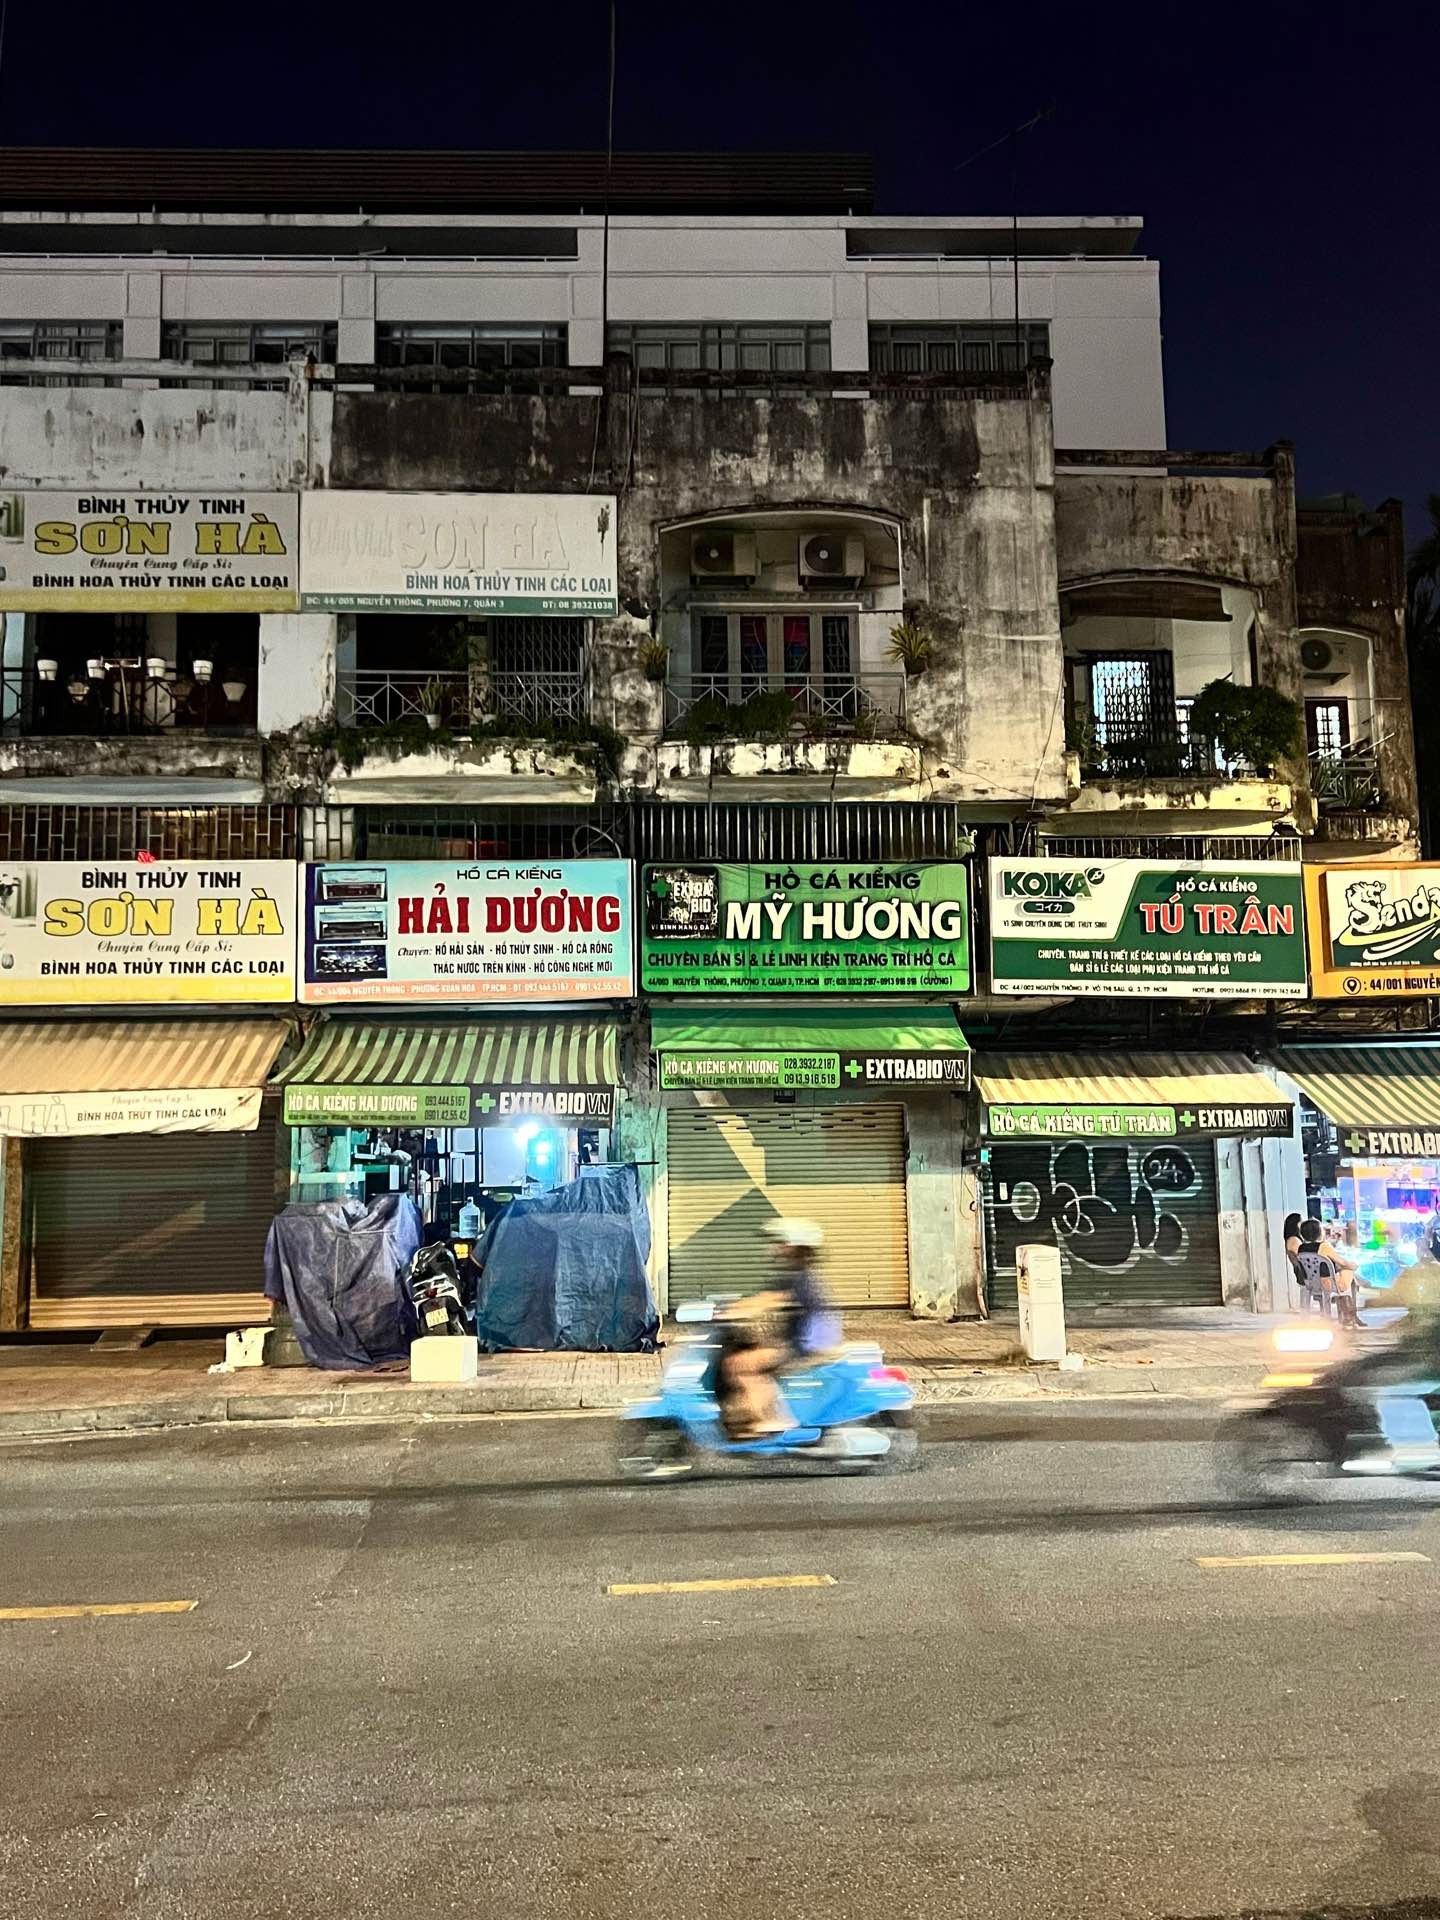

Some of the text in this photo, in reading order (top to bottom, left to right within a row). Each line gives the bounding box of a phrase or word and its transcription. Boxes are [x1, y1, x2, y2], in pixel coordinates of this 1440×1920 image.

[78, 495, 245, 514] BÌNH THỦY TINH
[34, 516, 171, 555] SƠN
[195, 513, 287, 554] HÀ
[90, 558, 139, 570] Chuyên
[144, 558, 178, 570] Cung
[32, 572, 288, 590] BÌNH HOA THỦY TINH CÁC LOẠI
[406, 570, 611, 595] BÌNH HOA THỦY TINH CÁC LOẠI
[82, 866, 241, 889] BÌNH THỦY TINH
[765, 866, 921, 889] HỒ CÁ KIỂNG
[1004, 872, 1092, 897] KOIKA
[1199, 878, 1217, 891] CÁ
[44, 888, 284, 937] SƠN HÀ
[397, 882, 620, 934] HẢI DƯƠNG
[692, 898, 711, 913] BIO
[1035, 903, 1063, 912] コイカ
[1140, 893, 1294, 934] TÚ TRÂN
[725, 892, 961, 940] MỸ HƯƠNG
[148, 940, 181, 954] Cung
[533, 944, 554, 954] SINH
[40, 957, 285, 977] BÌNH HOA THỦY TINH CÁC LOẠI
[648, 951, 699, 966] CHUYÊN
[703, 951, 730, 966] BÁN
[779, 953, 807, 966] LINH
[811, 951, 839, 968] KIỆN
[843, 953, 888, 966] TRANG
[1370, 978, 1402, 990] 44/001
[783, 1058, 836, 1070] 028.3932.2187
[22, 1096, 69, 1134] HÀ
[156, 1110, 178, 1119] TINH
[1018, 1111, 1041, 1132] CÁ
[1044, 1107, 1094, 1132] KIỂNG
[1098, 1111, 1120, 1132] TÚ
[1124, 1113, 1172, 1133] TRÂN
